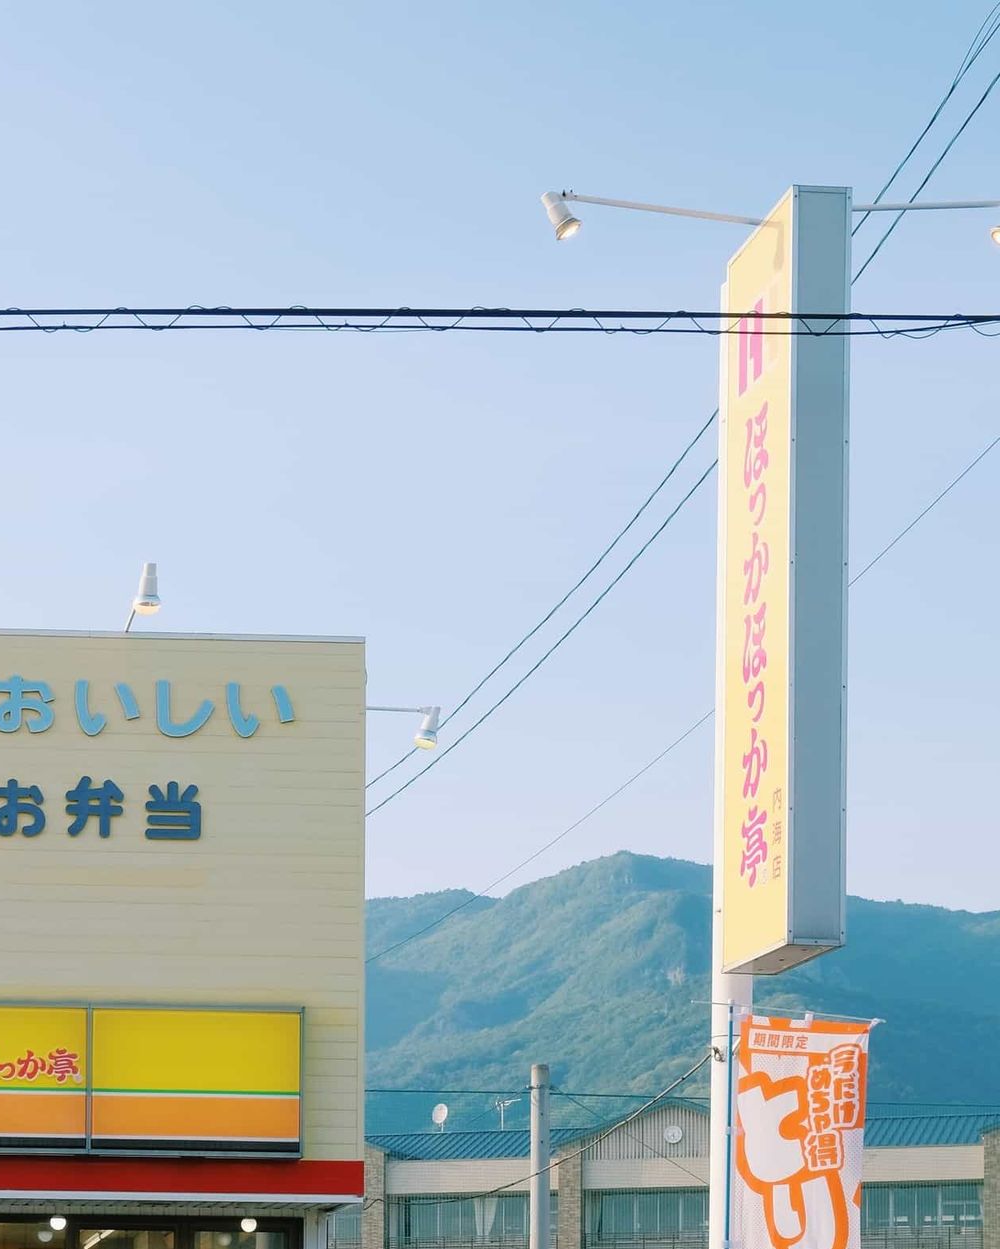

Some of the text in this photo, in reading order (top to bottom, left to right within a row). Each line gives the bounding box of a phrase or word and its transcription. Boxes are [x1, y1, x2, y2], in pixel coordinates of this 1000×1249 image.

[741, 401, 769, 888] ほっかほっか亭
[753, 1033, 809, 1050] 期間限定
[831, 1047, 860, 1126] 今だけ
[808, 1067, 838, 1168] めちゃ得
